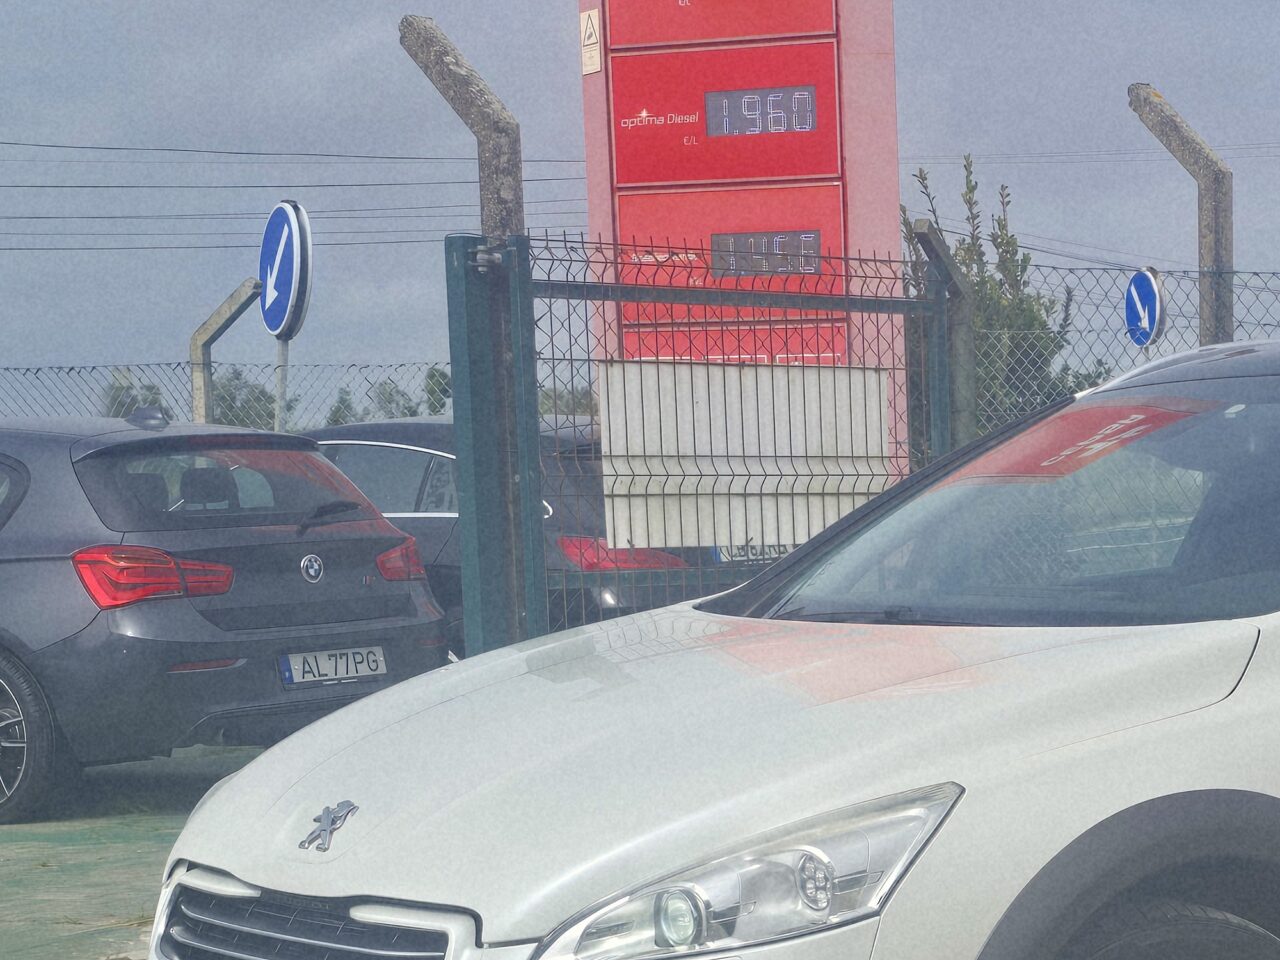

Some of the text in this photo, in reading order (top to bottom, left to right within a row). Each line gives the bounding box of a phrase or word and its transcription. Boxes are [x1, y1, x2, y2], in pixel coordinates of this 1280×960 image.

[620, 111, 699, 130] optima Diesel
[723, 92, 812, 135] 1.960
[683, 136, 699, 146] €/L
[302, 650, 379, 680] AL77PG
